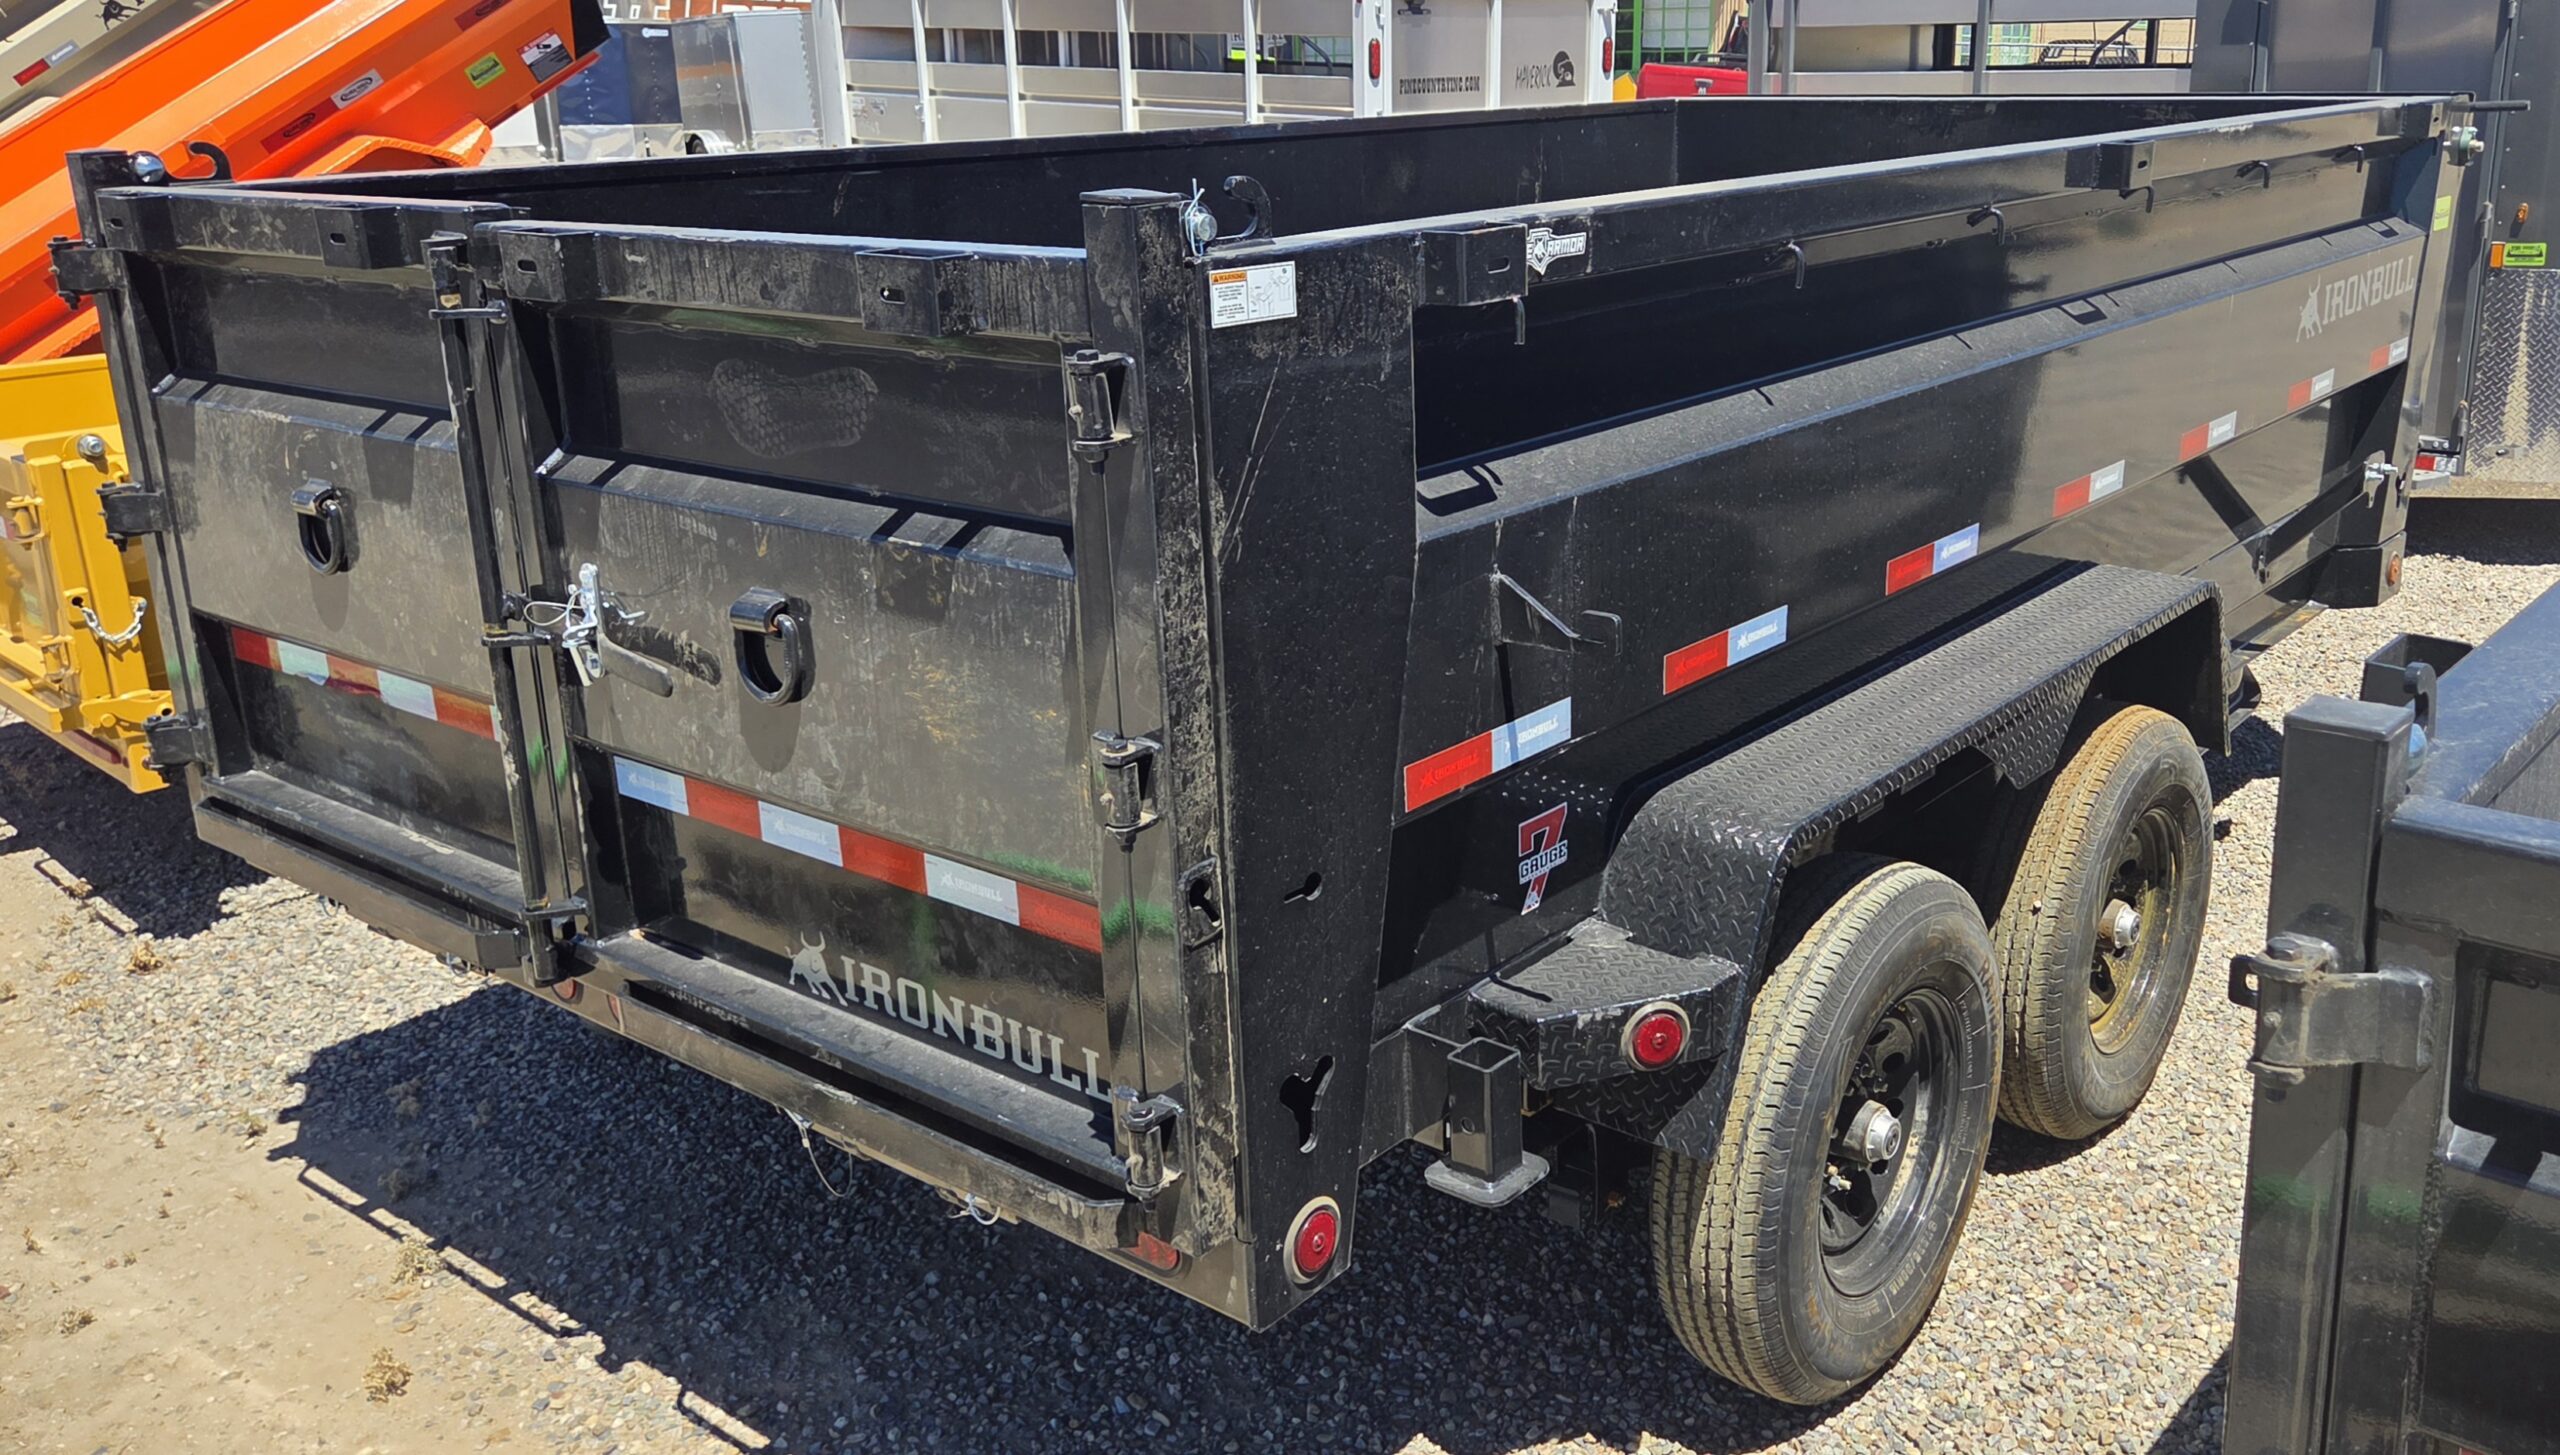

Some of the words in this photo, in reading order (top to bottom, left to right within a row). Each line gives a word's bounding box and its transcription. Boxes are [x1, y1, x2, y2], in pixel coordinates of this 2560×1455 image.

[1515, 64, 1552, 91] MAVERICK
[1547, 236, 1585, 256] ARMOR
[2322, 255, 2415, 325] IRONBULL
[1520, 842, 1567, 879] GAUGE
[840, 954, 1113, 1104] IRONBULL
